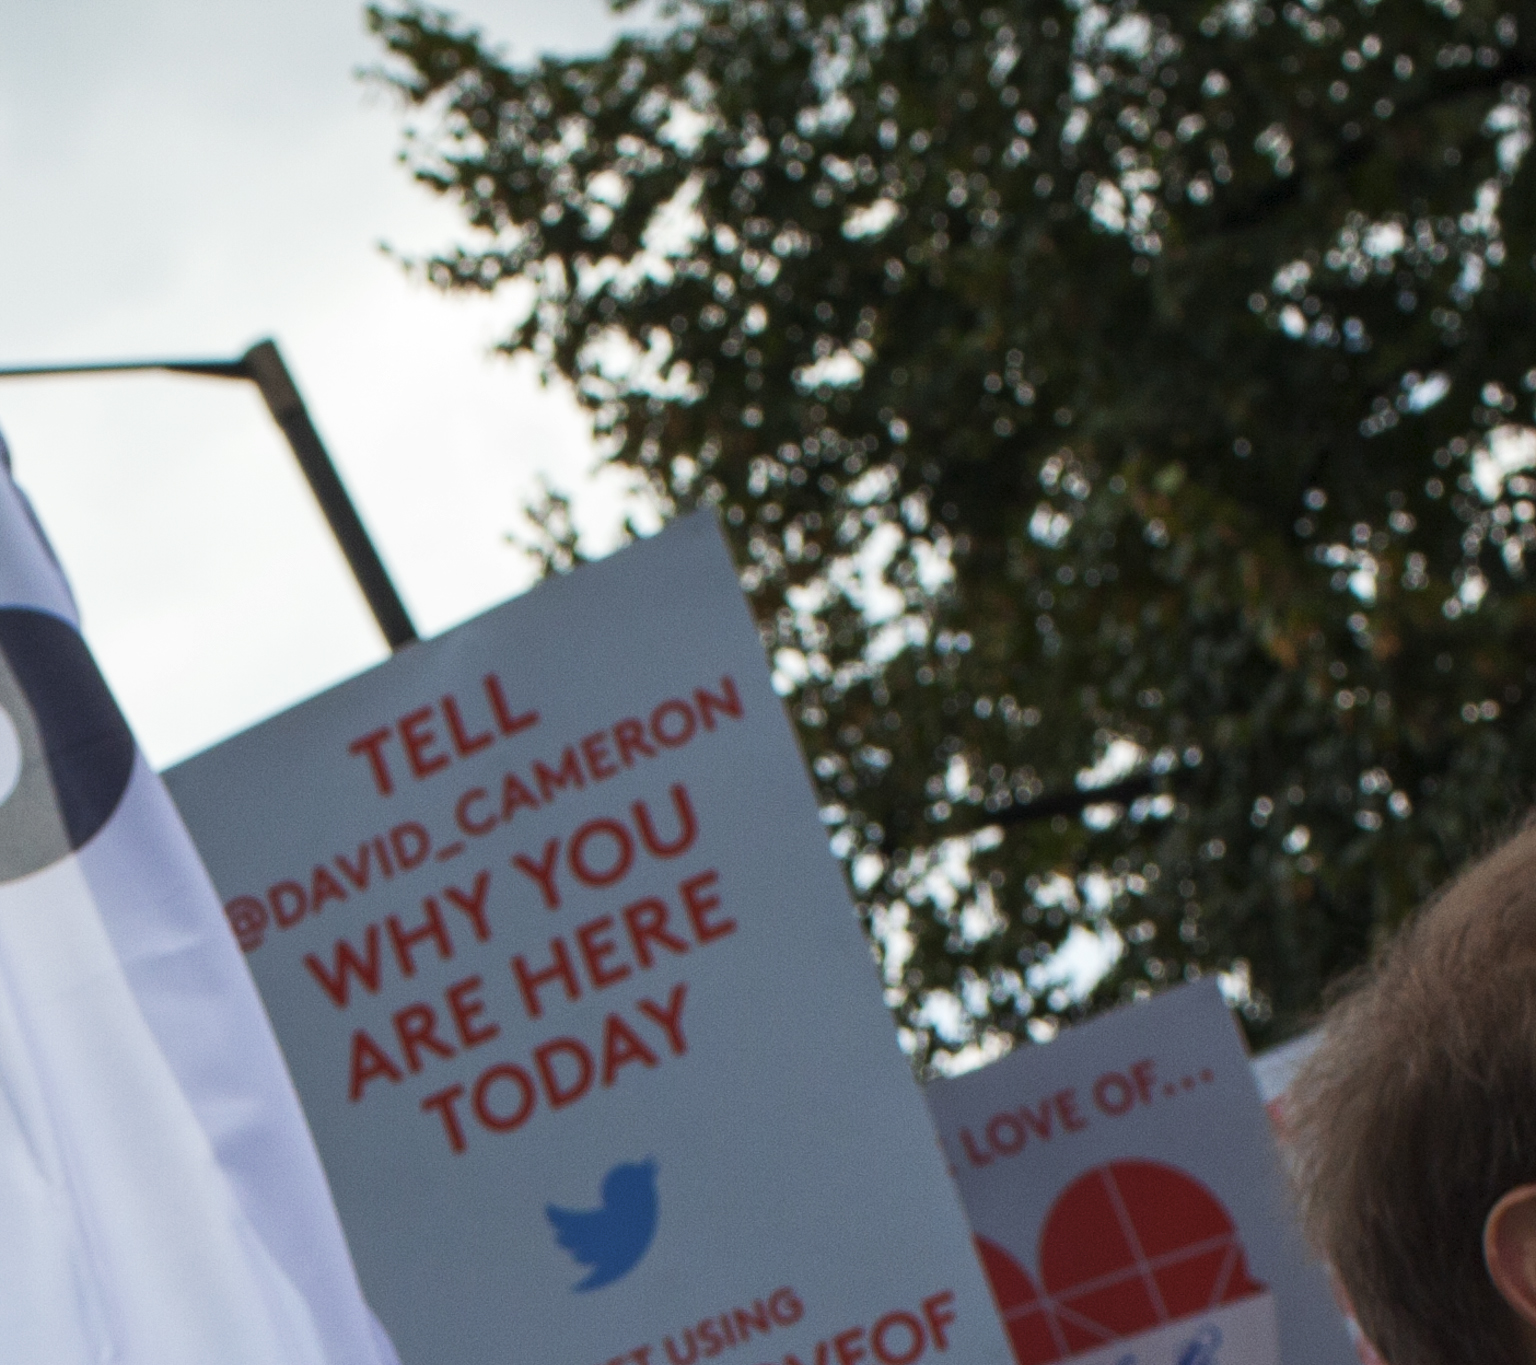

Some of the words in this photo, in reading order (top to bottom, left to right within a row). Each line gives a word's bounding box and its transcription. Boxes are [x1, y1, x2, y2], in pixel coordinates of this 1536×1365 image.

[227, 674, 747, 954] @DAVID_CAMERON
[348, 672, 540, 799] TELL
[304, 869, 494, 1012] WHY
[510, 782, 702, 912] YOU
[346, 977, 501, 1103] ARE
[510, 869, 738, 1022] HERE
[420, 983, 693, 1157] TODAY
[959, 1089, 1084, 1170] LOVE
